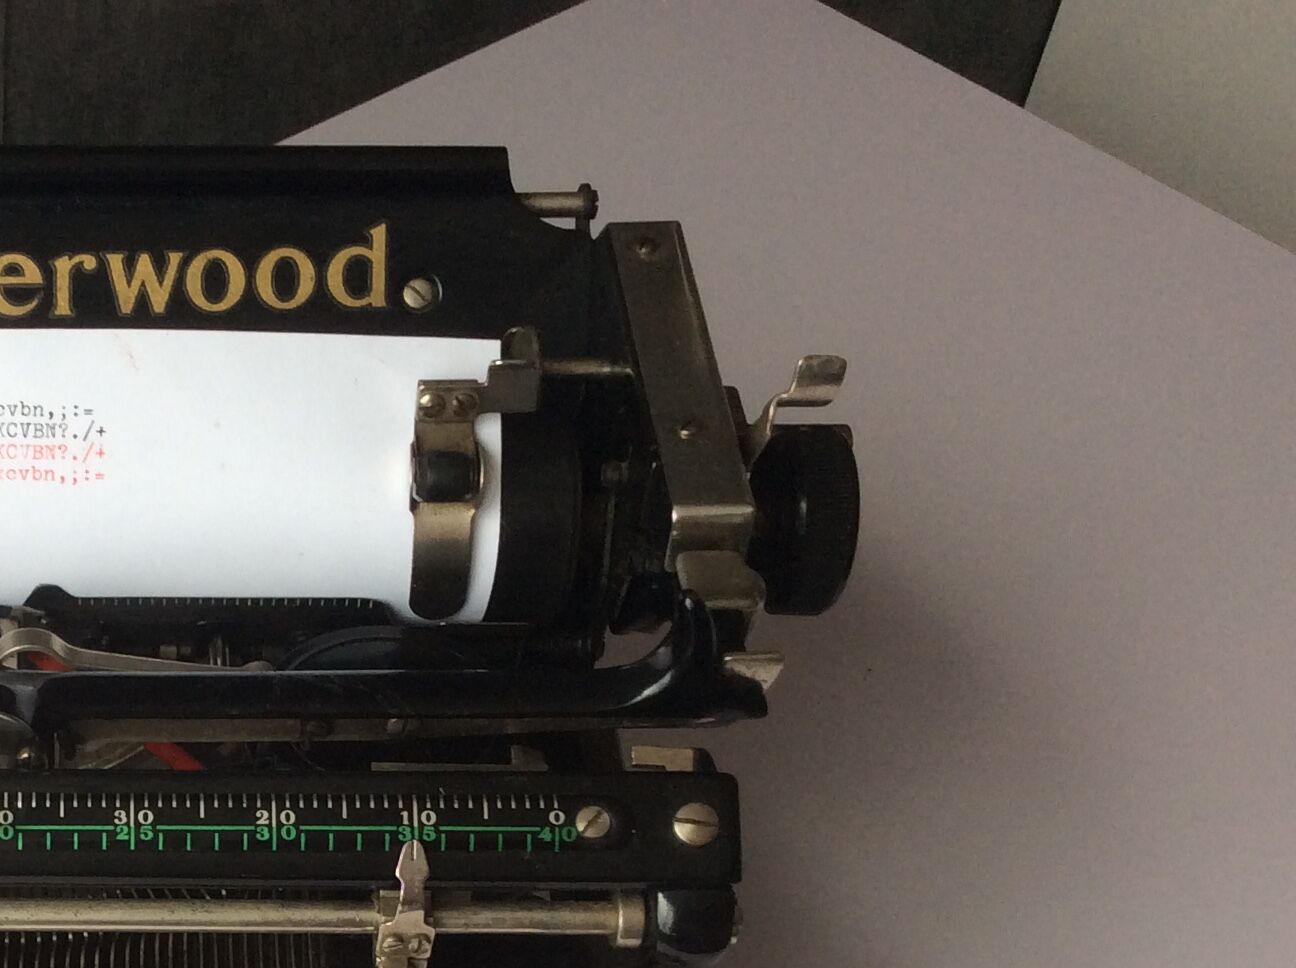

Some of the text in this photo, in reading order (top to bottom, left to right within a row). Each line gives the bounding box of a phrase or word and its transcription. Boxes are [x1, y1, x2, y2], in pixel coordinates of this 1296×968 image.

[114, 810, 154, 825] 30
[255, 810, 296, 825] 20
[549, 810, 566, 826] 0
